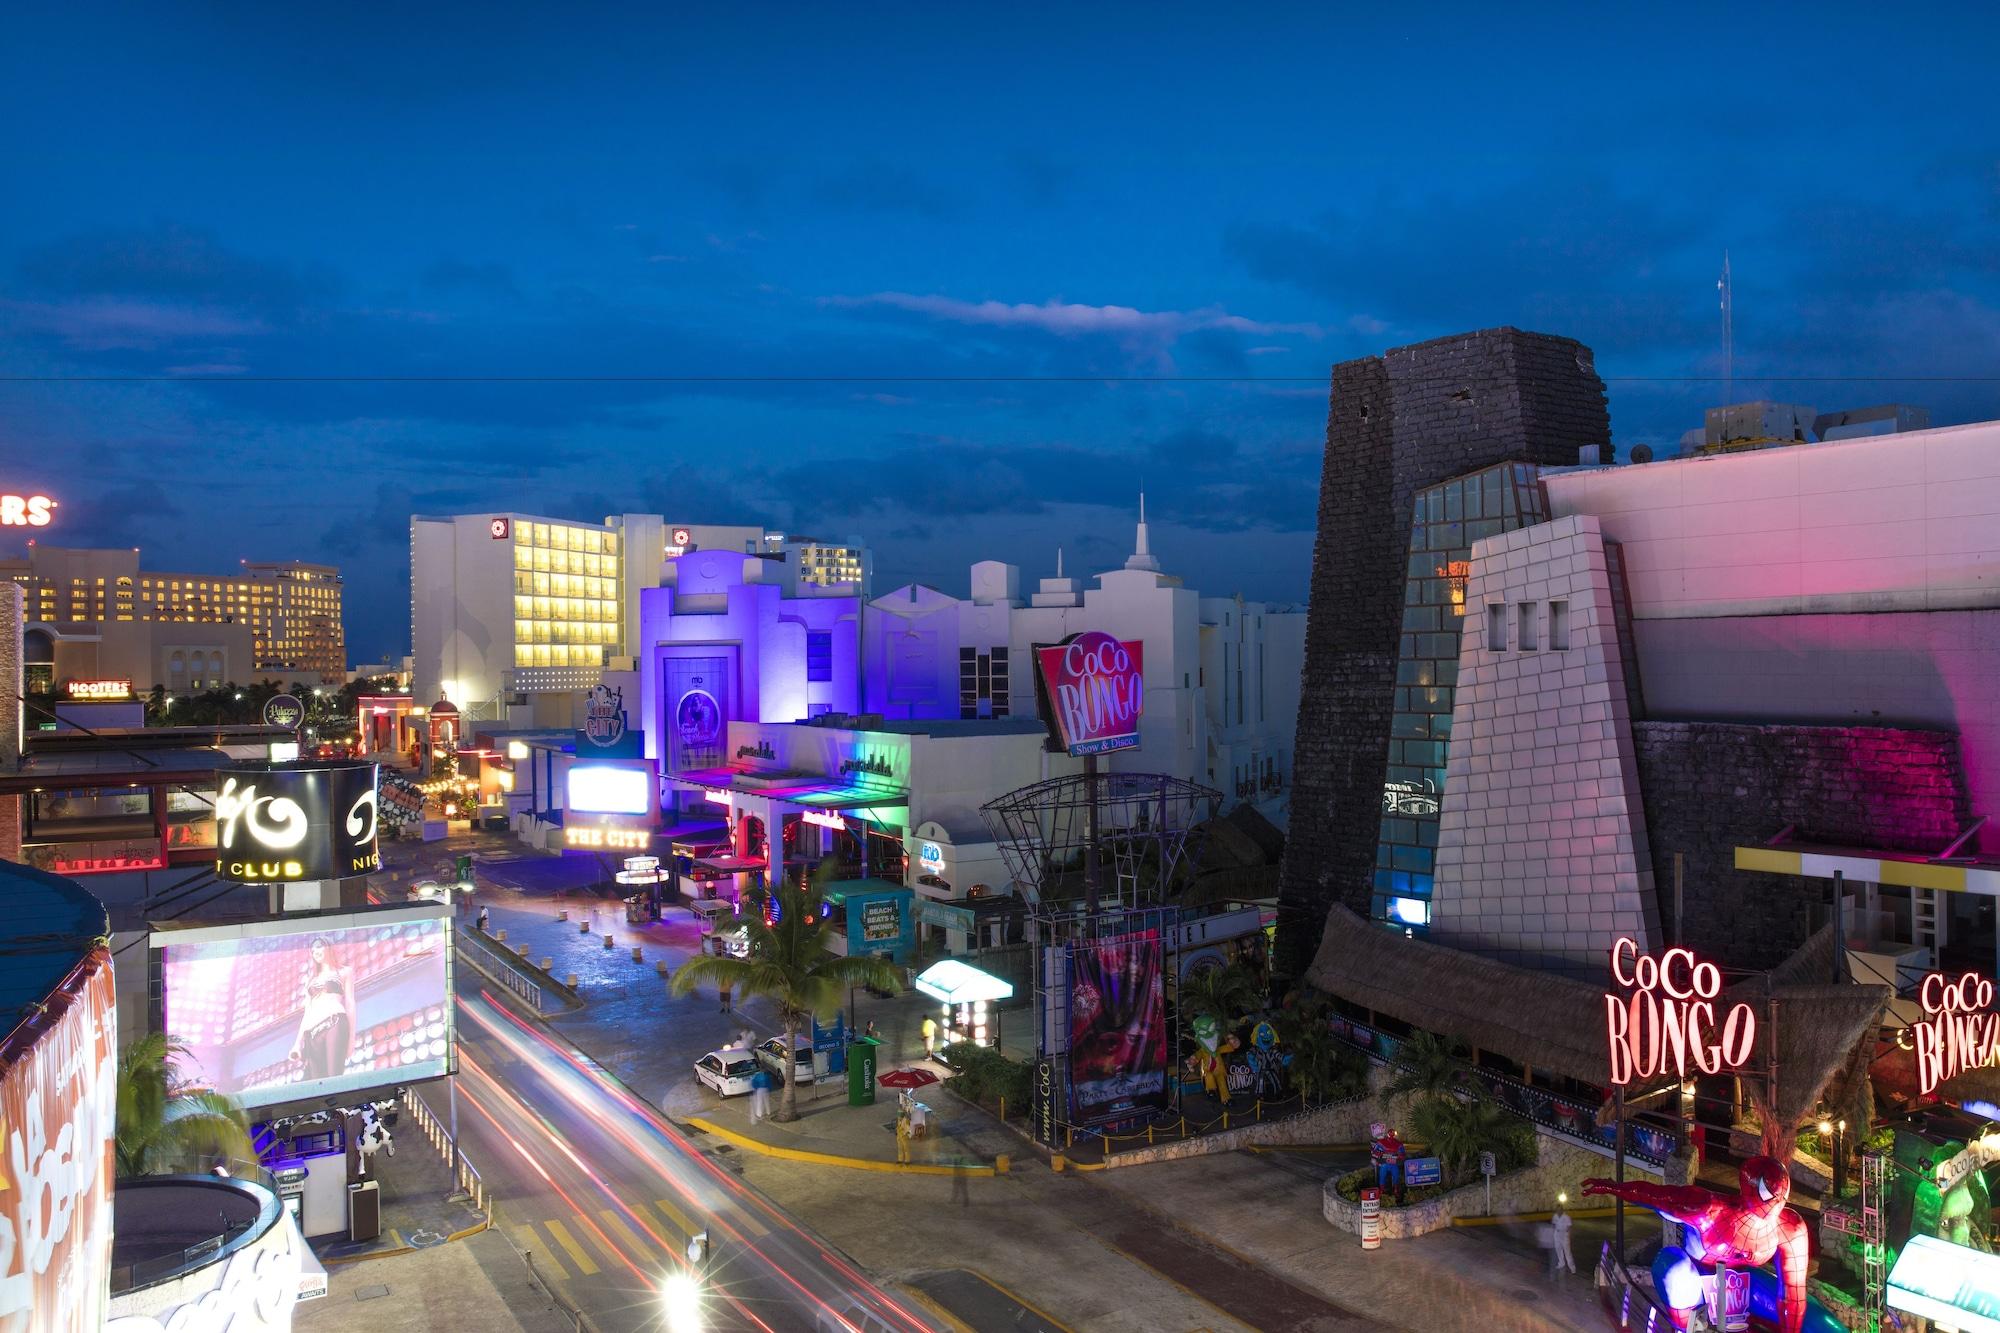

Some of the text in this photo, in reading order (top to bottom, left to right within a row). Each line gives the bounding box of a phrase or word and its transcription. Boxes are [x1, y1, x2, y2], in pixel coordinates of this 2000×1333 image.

[69, 682, 129, 693] HOOTERS
[1057, 672, 1143, 744] BONGO
[587, 719, 620, 737] CITY
[1076, 737, 1134, 755] Show & Disco
[566, 827, 650, 849] THE CITY
[231, 862, 302, 877] CLUB
[869, 906, 893, 915] BEACH
[867, 916, 889, 924] BEATS
[1605, 988, 1756, 1085] BONGO
[1913, 1009, 1999, 1095] BONGO
